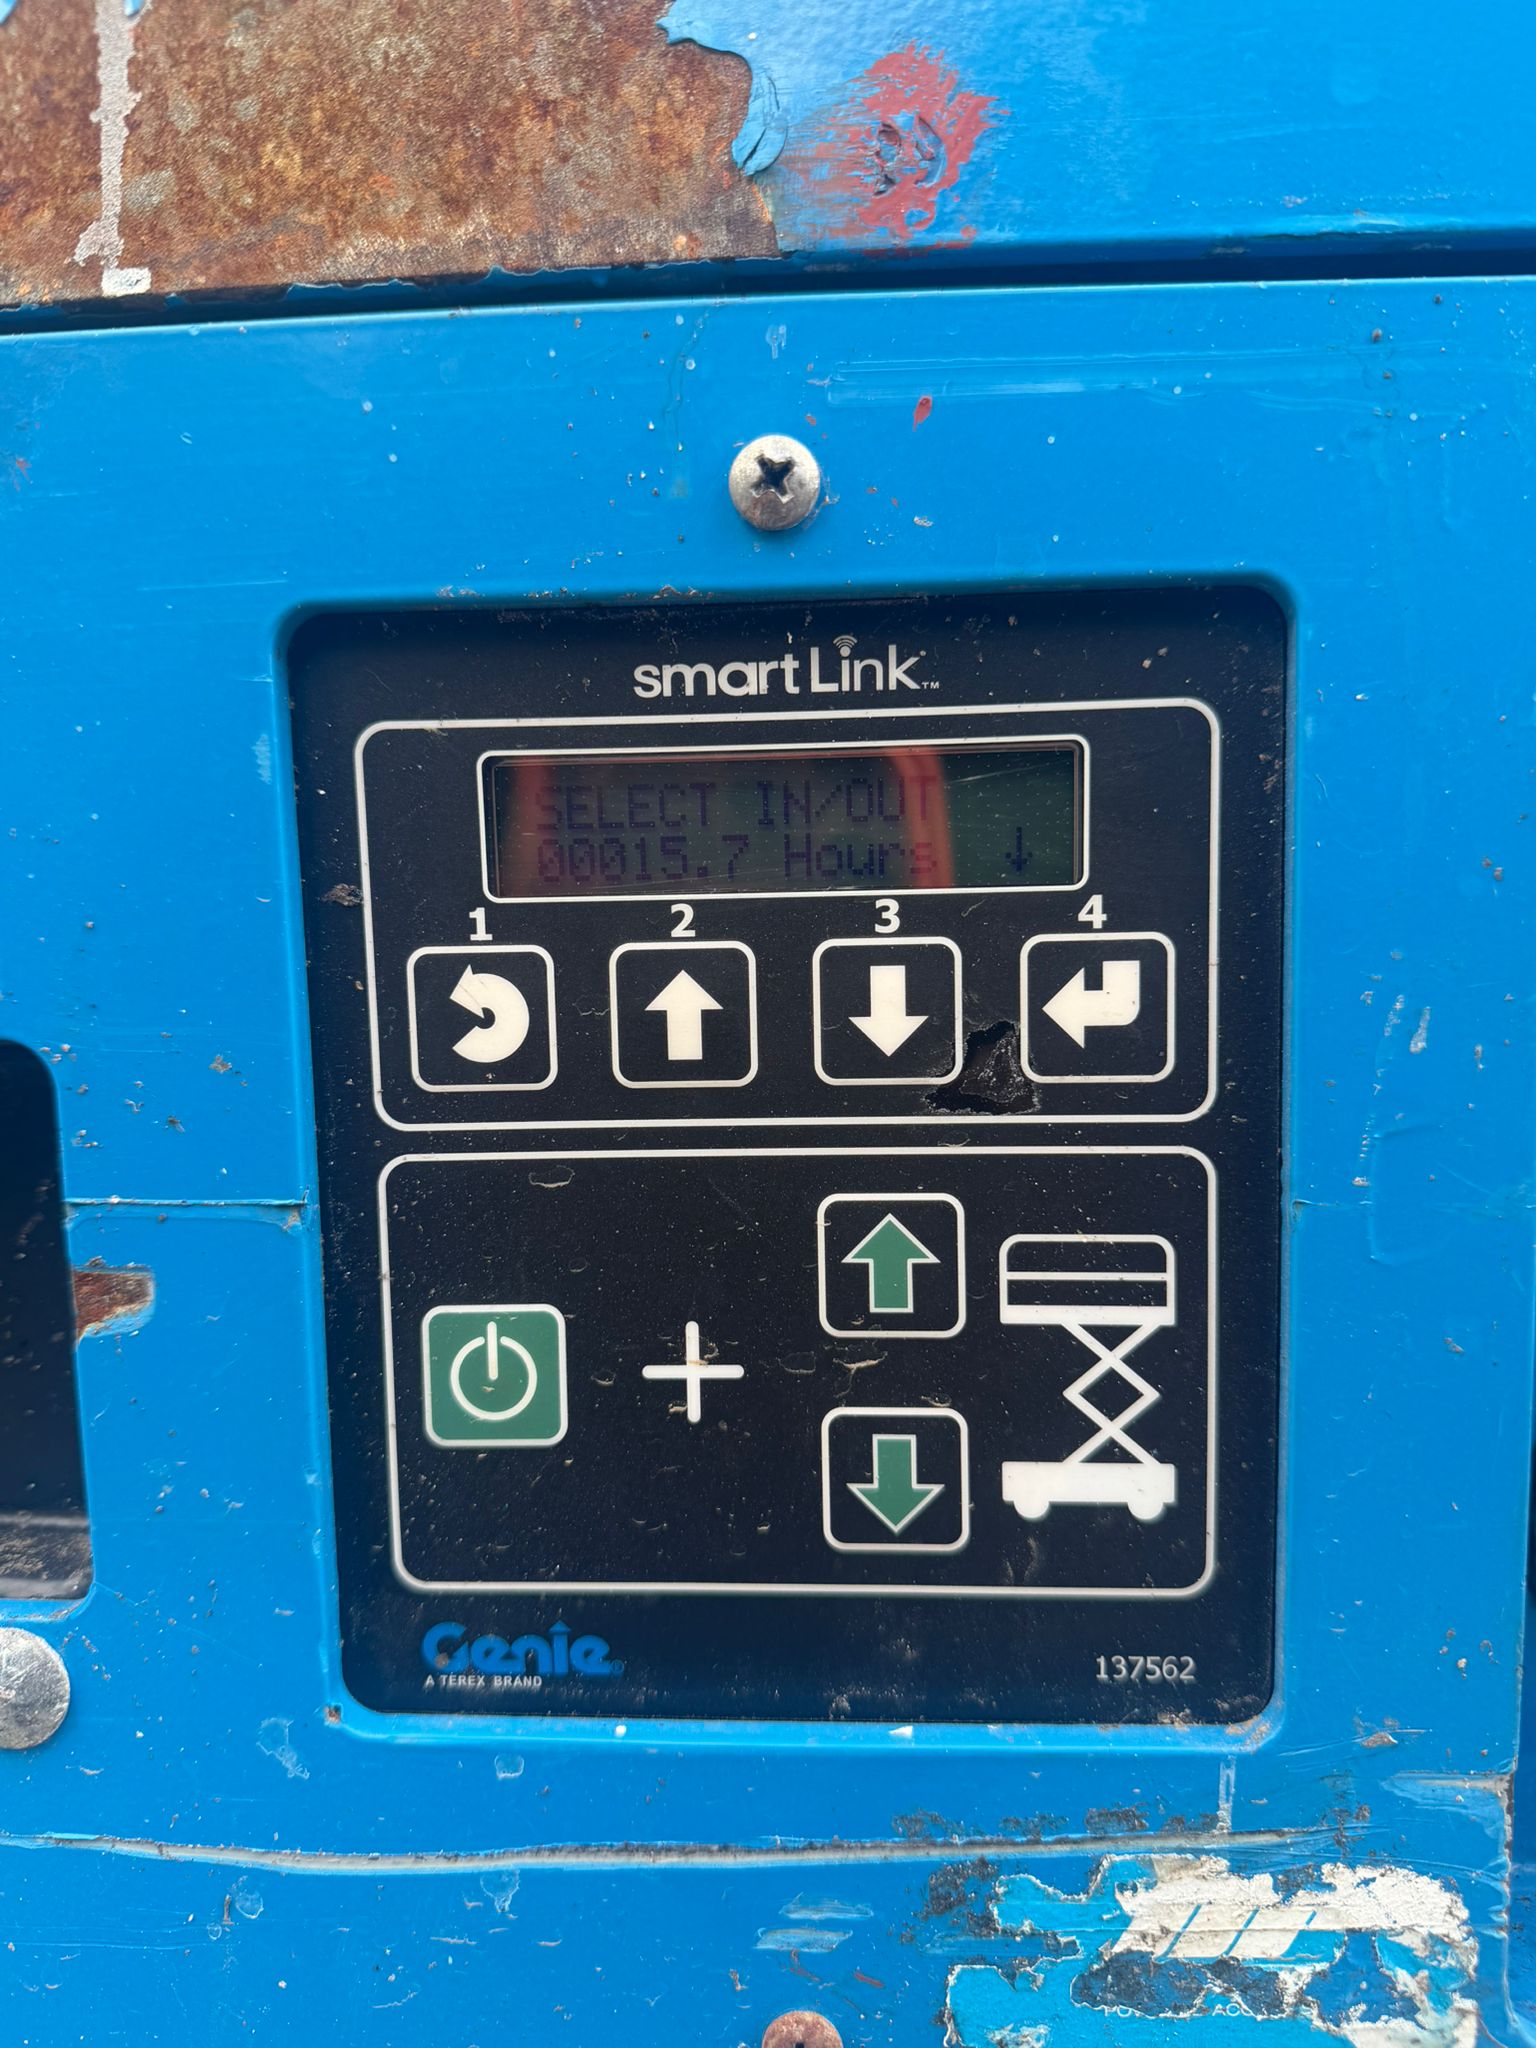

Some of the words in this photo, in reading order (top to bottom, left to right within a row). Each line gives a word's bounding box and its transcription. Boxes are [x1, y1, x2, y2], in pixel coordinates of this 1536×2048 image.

[633, 653, 800, 699] smart
[536, 782, 717, 830] SELECT
[756, 776, 937, 825] IN/OUT
[538, 834, 749, 883] 00015.7
[784, 833, 937, 878] Hours
[469, 907, 493, 942] 1
[670, 903, 696, 938] 2
[874, 898, 901, 934] 3
[1077, 894, 1108, 929] 4
[425, 1674, 435, 1688] A
[439, 1674, 485, 1687] TEREX
[493, 1675, 542, 1688] BRAND
[1096, 1655, 1196, 1682] 137562
